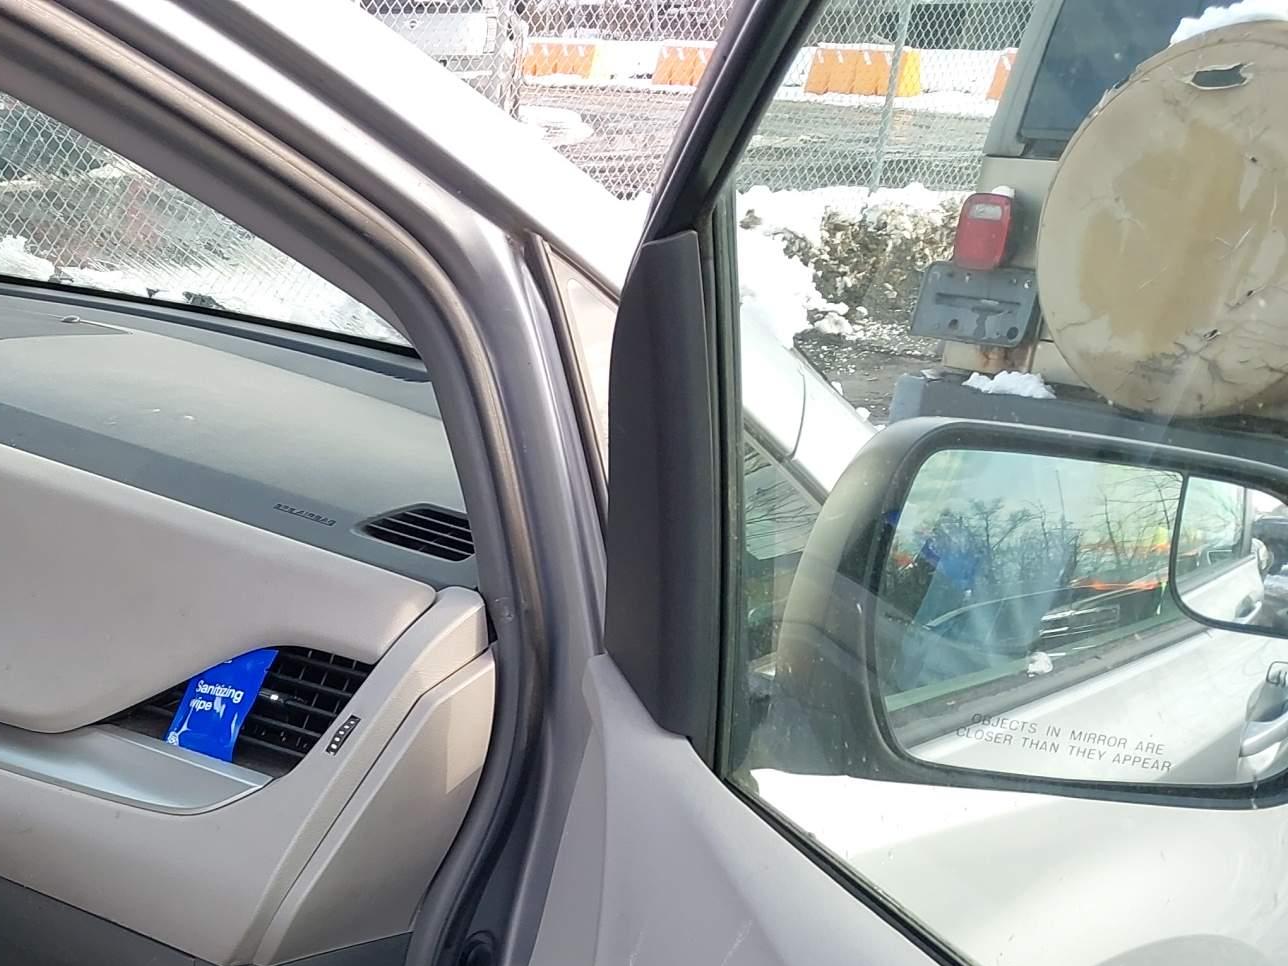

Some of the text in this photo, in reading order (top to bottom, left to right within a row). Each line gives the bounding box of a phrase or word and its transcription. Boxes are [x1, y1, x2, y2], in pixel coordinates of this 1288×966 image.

[196, 680, 244, 703] Sanitizing
[956, 726, 1172, 773] CLOSER THAN THEY APPEAR
[972, 713, 1166, 756] OBJECTS IN MIRROR ARE
